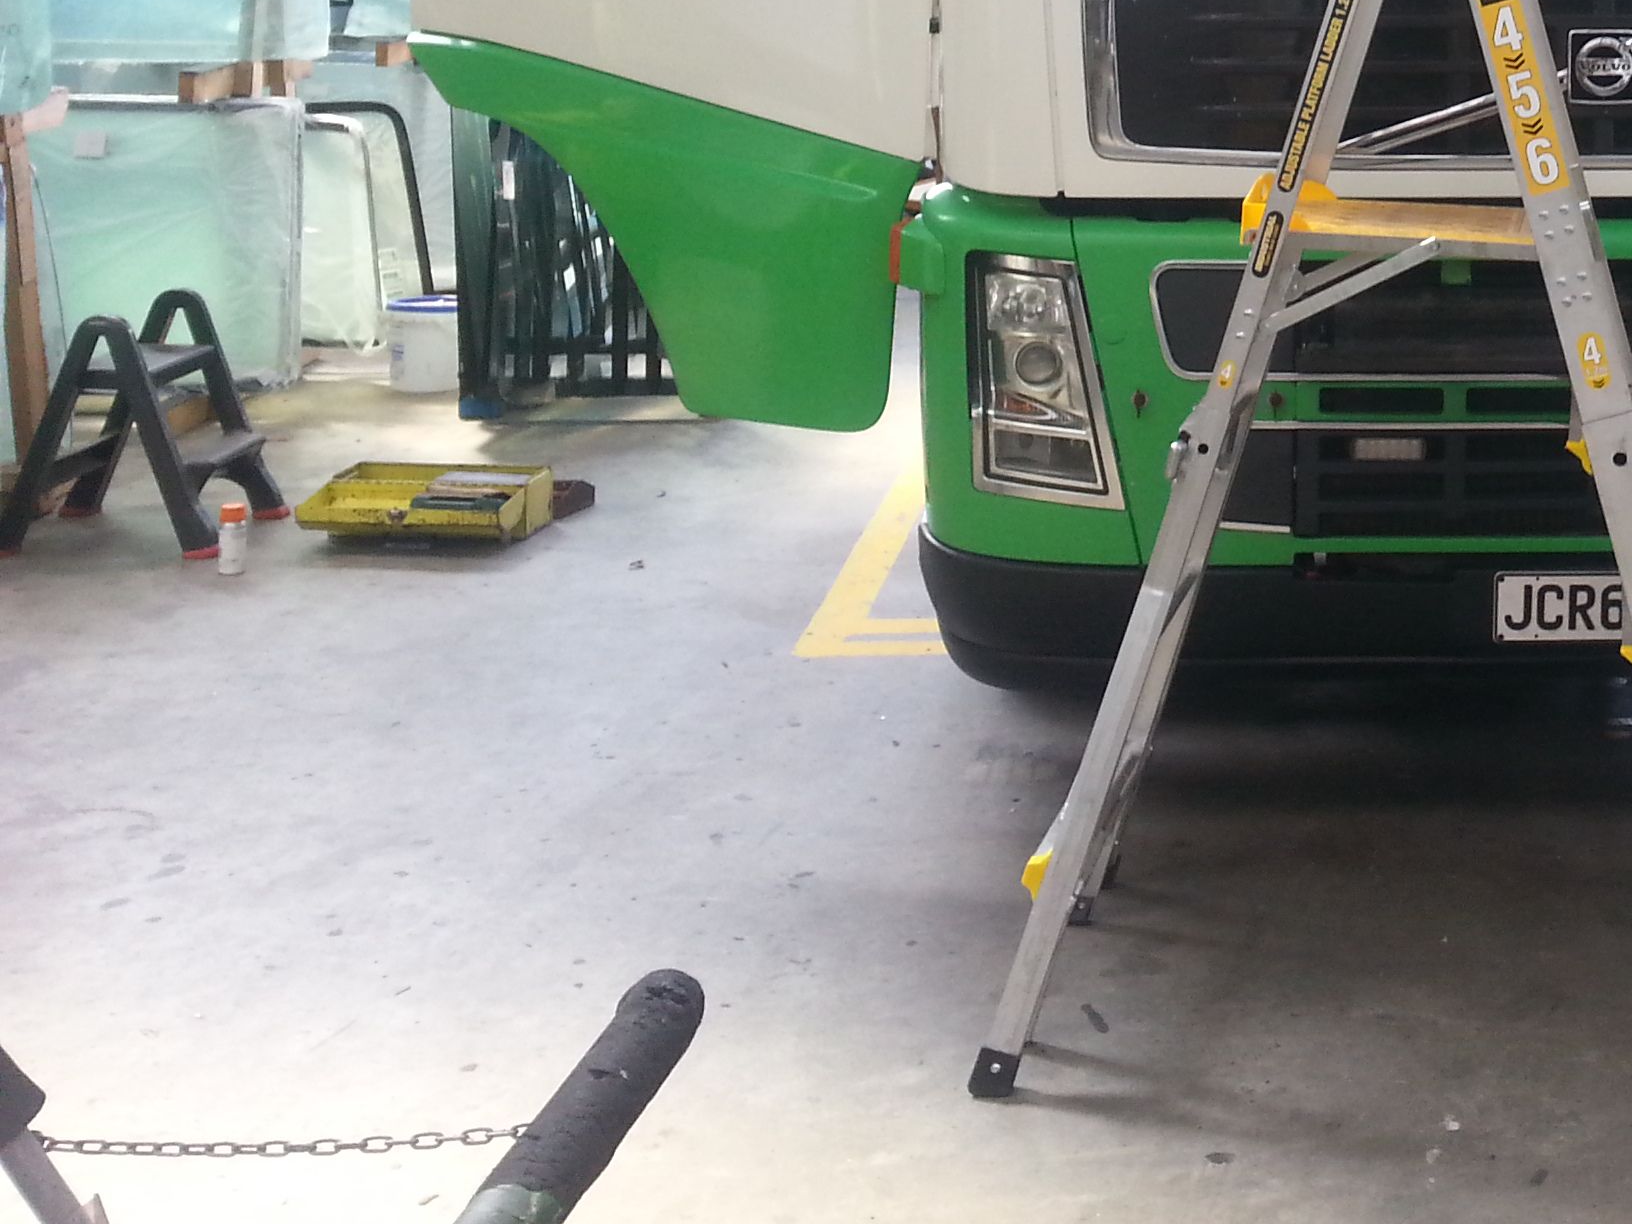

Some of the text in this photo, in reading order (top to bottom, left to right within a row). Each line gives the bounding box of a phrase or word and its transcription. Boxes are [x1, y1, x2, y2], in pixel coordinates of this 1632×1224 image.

[1492, 7, 1524, 51] 4
[1579, 59, 1632, 73] VOLVO
[1506, 70, 1542, 119] 5
[1525, 138, 1560, 185] 6
[1583, 336, 1602, 365] 4
